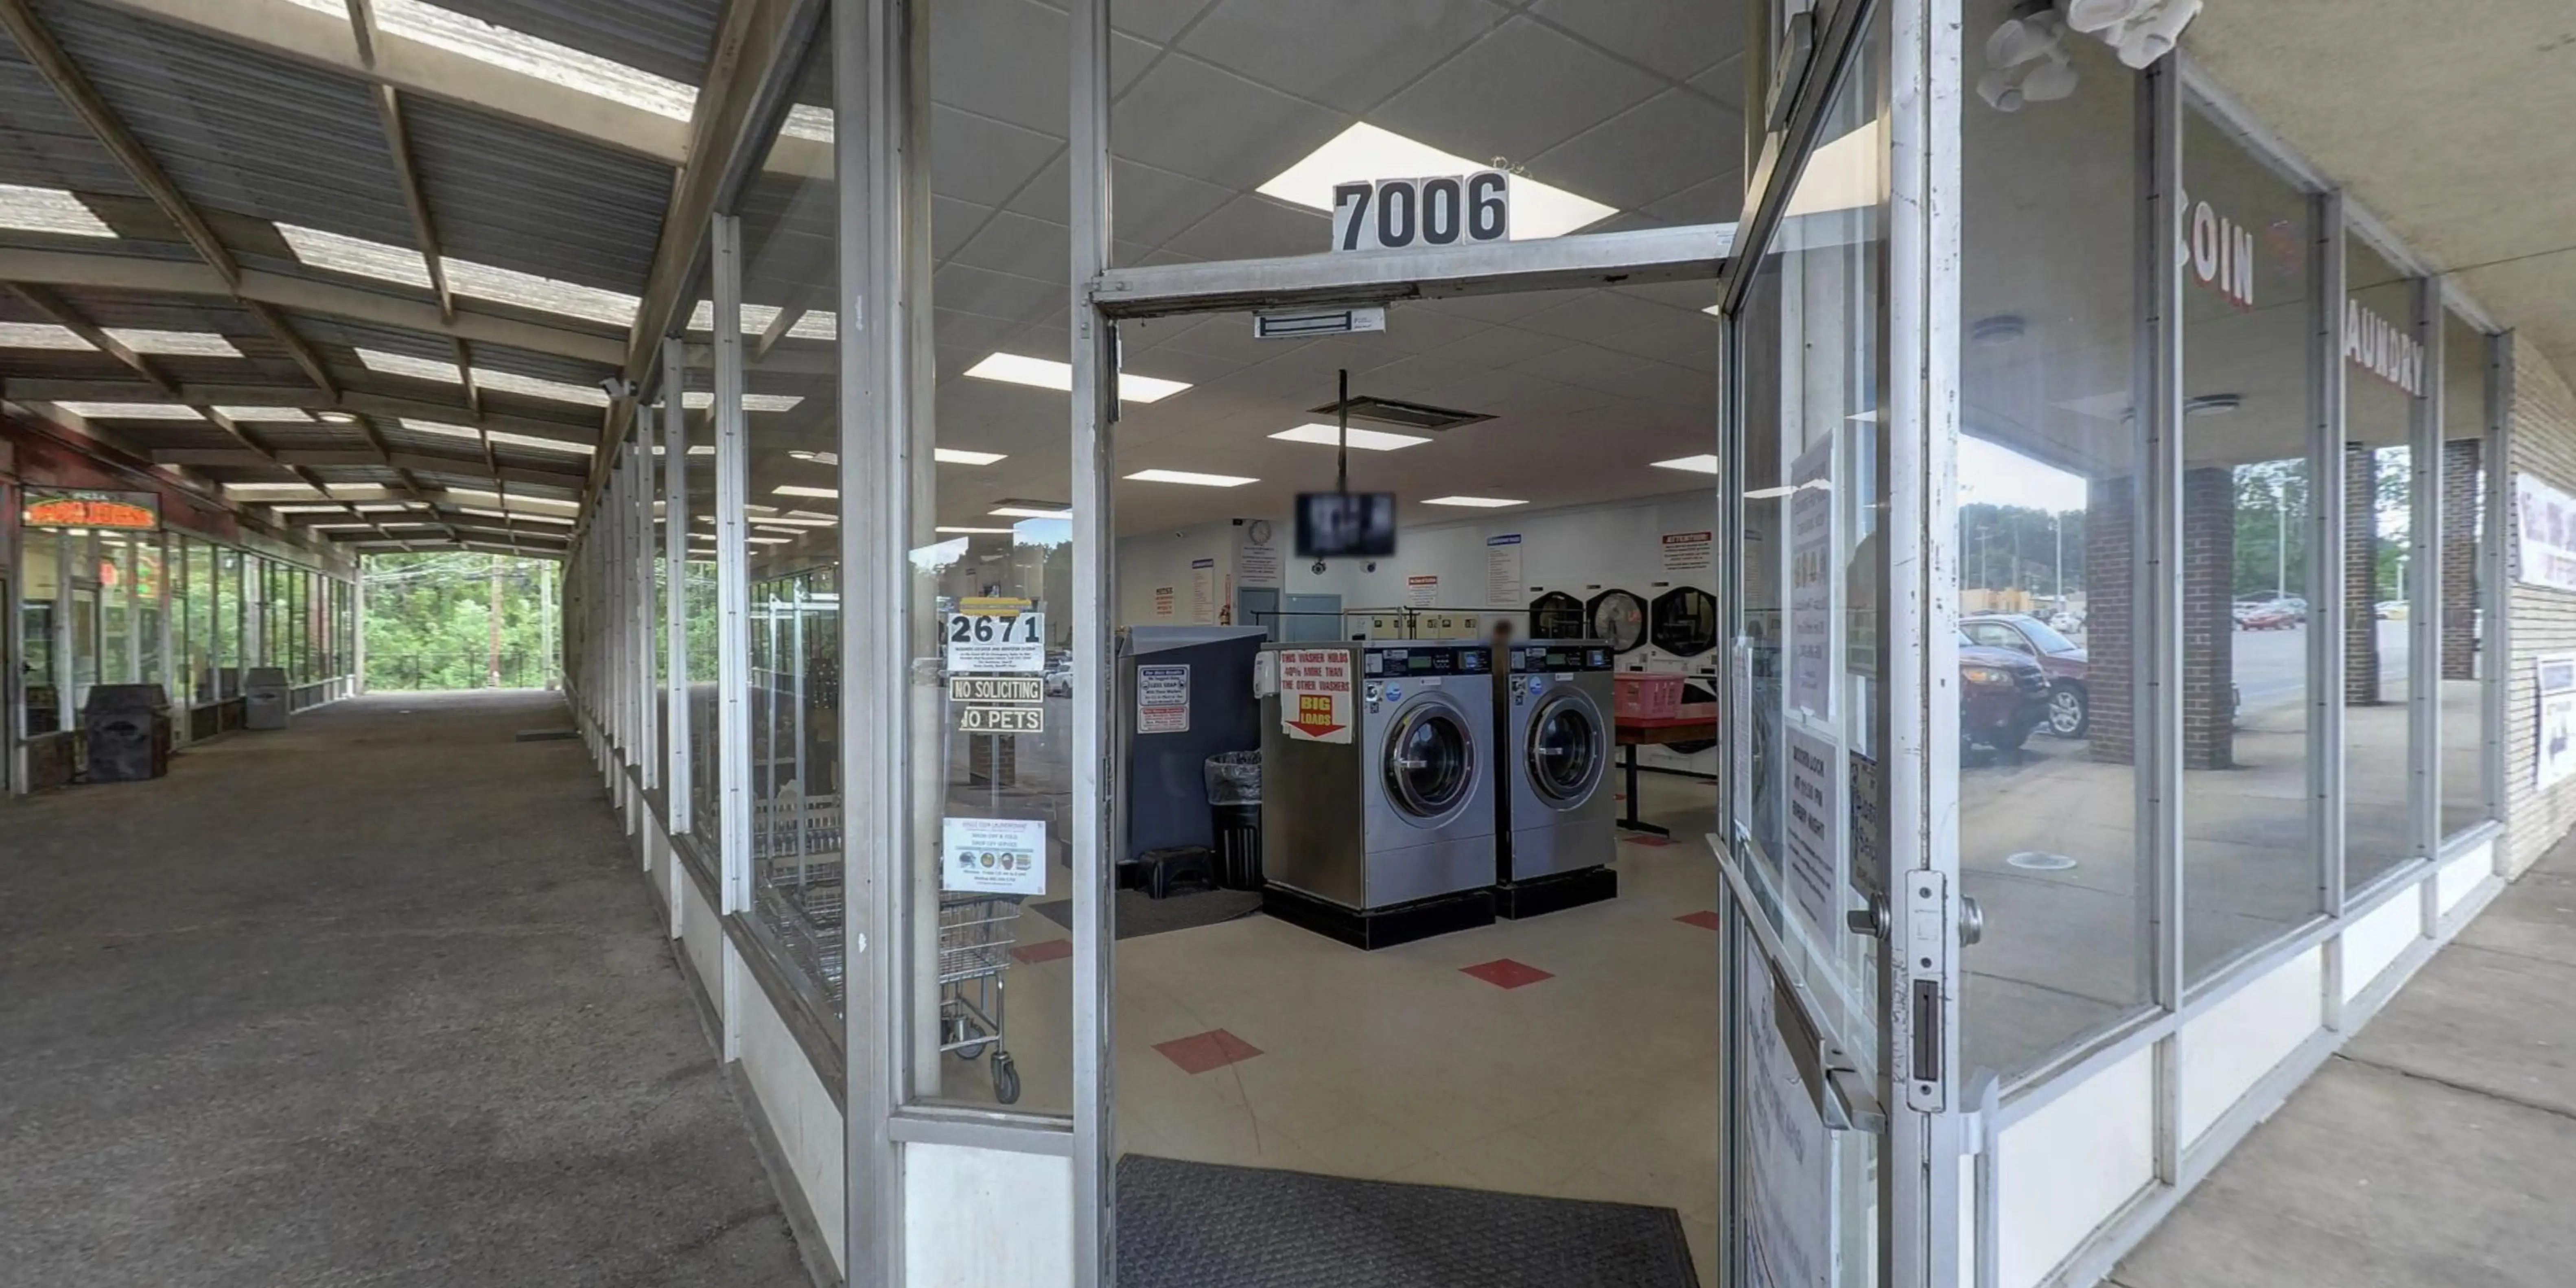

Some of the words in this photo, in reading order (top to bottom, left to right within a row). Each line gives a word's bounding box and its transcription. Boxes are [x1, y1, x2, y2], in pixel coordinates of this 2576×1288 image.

[1336, 173, 1507, 250] 7006
[2342, 298, 2424, 395] AUNDRY
[951, 616, 1039, 643] 2671
[1299, 653, 1325, 663] WASHER
[1304, 667, 1321, 676] MORE
[1325, 667, 1343, 677] THAN
[955, 681, 971, 698] NO
[976, 681, 1038, 698] SOLICITING
[1282, 680, 1293, 689] THE
[1297, 680, 1316, 691] OTHER
[1319, 681, 1350, 691] WASHERS
[1301, 697, 1331, 710] BIG
[989, 711, 1039, 728] PETS
[1301, 713, 1331, 726] LOADS
